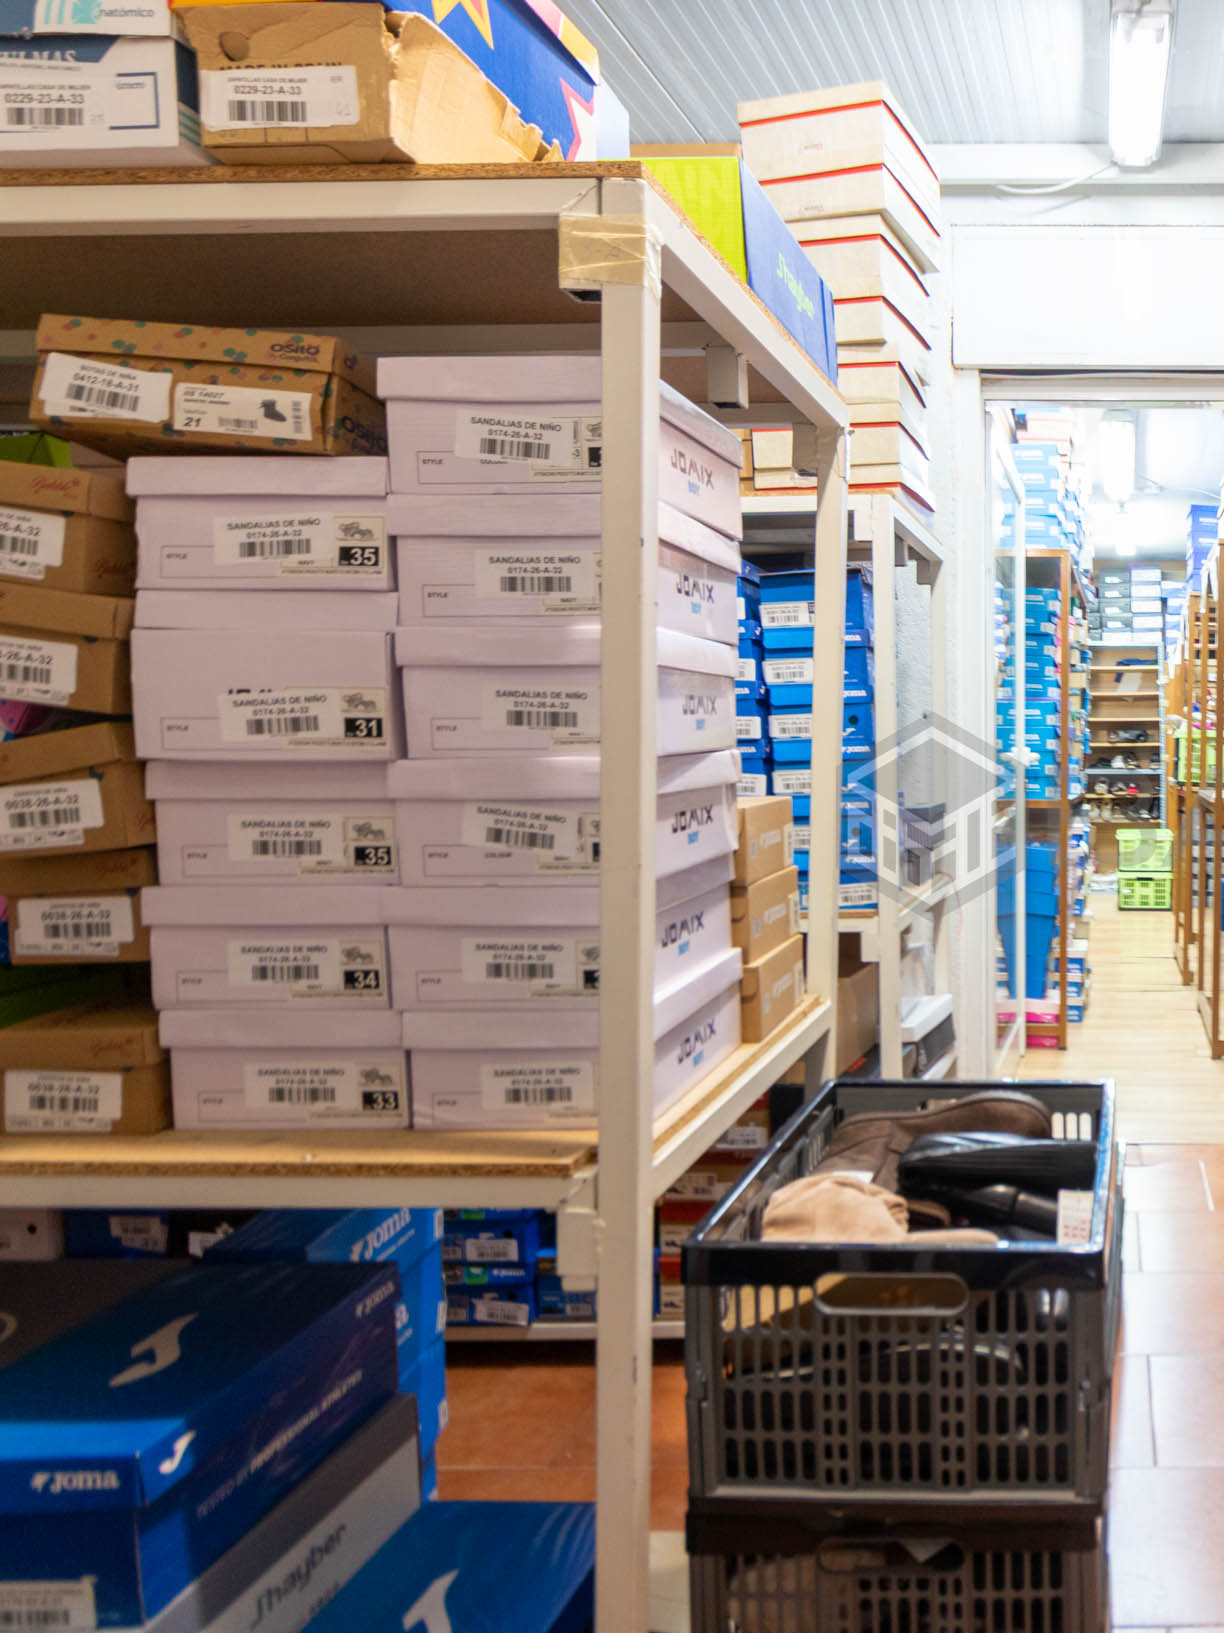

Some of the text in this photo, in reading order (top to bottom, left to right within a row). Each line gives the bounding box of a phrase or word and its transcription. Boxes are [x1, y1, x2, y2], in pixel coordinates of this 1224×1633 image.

[234, 85, 302, 95] 0229-23-A-33
[184, 417, 201, 428] 21
[471, 416, 562, 432] SANDALIAS DE NIÑO
[670, 448, 714, 489] JOMIX
[227, 517, 321, 531] SANDALIAS DE NIÑO
[350, 548, 376, 565] 35
[489, 555, 581, 565] SANDALIAS DE NIÑO
[677, 574, 714, 604] JOMIX
[232, 698, 287, 708] SANDALIAS
[288, 697, 302, 705] DE
[495, 689, 588, 700] SANDALIAS DE NIÑO
[682, 694, 718, 716] JOMIX
[355, 719, 379, 736] 31
[477, 805, 567, 823] SANDALIAS DE NIÑO
[672, 805, 713, 834] JOMIX
[240, 820, 294, 829] SANDALIAS
[296, 820, 310, 828] DE
[364, 847, 390, 865] 35
[662, 911, 704, 948] JOMIX
[354, 971, 378, 989] 34
[678, 1017, 716, 1064] JOMIX
[373, 1092, 396, 1110] 33
